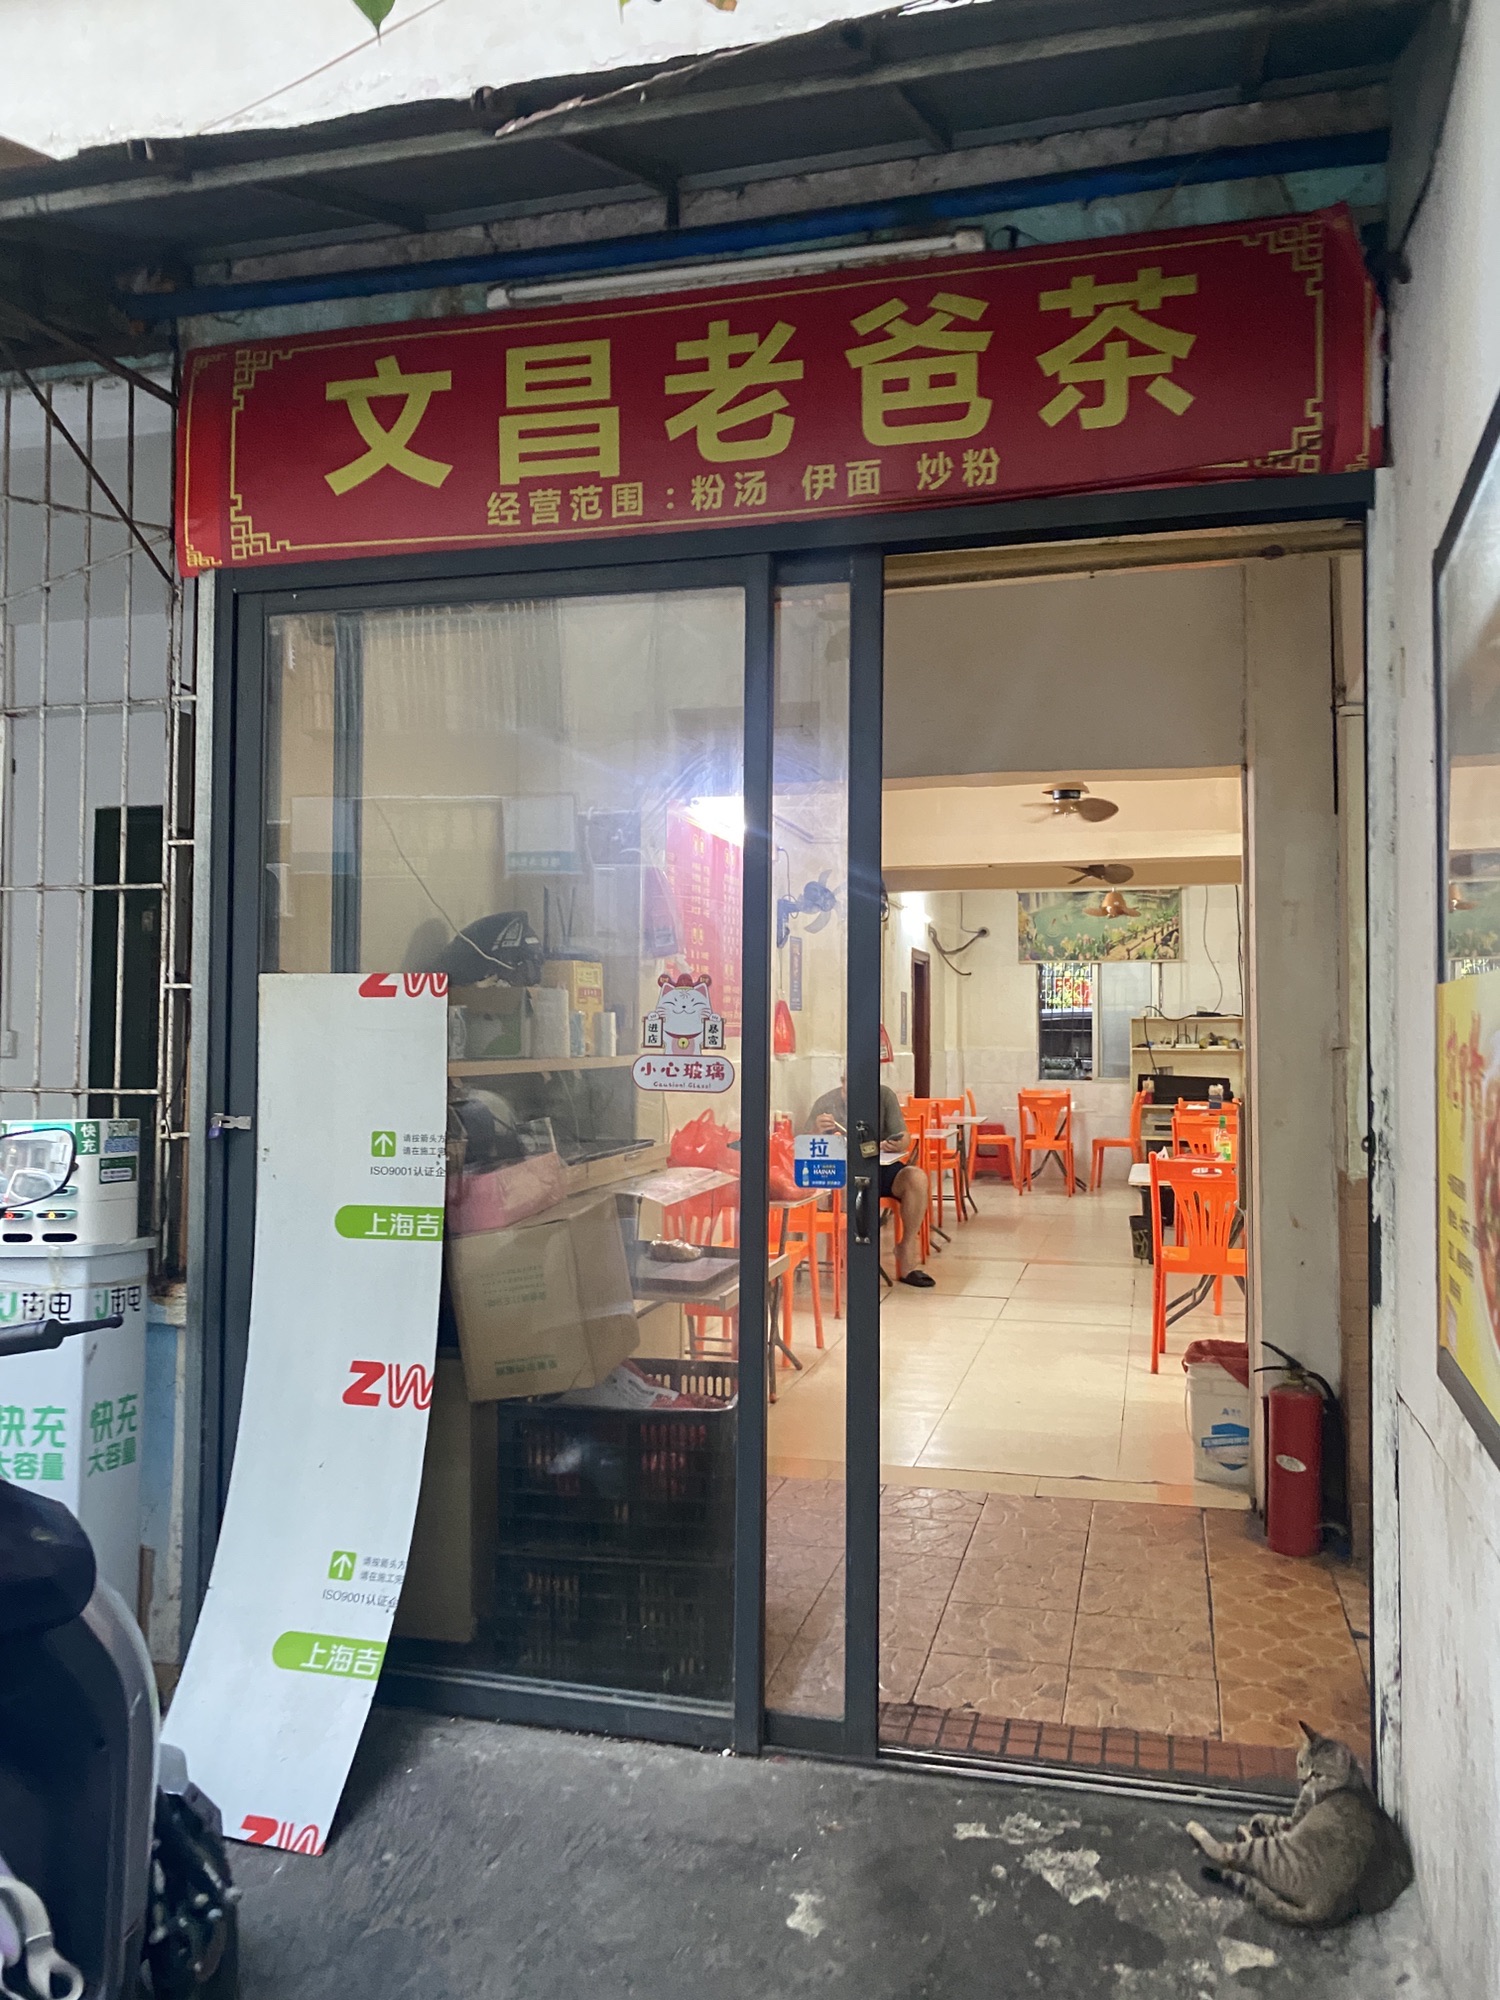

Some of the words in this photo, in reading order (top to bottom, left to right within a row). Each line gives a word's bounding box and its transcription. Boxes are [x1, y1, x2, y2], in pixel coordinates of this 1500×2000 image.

[324, 266, 1198, 496] 文昌老爸茶
[802, 459, 882, 501] 伊面
[917, 447, 1001, 491] 炒粉
[648, 1023, 659, 1044] 进店
[708, 1023, 719, 1045] 暴富
[640, 1061, 725, 1081] 小心玻璃
[81, 1123, 97, 1153] 快充
[809, 1138, 829, 1158] 拉
[364, 1212, 440, 1237] 上海吉
[89, 1394, 138, 1444] 快充
[87, 1437, 137, 1478] 大容量
[300, 1641, 382, 1676] 上海吉
